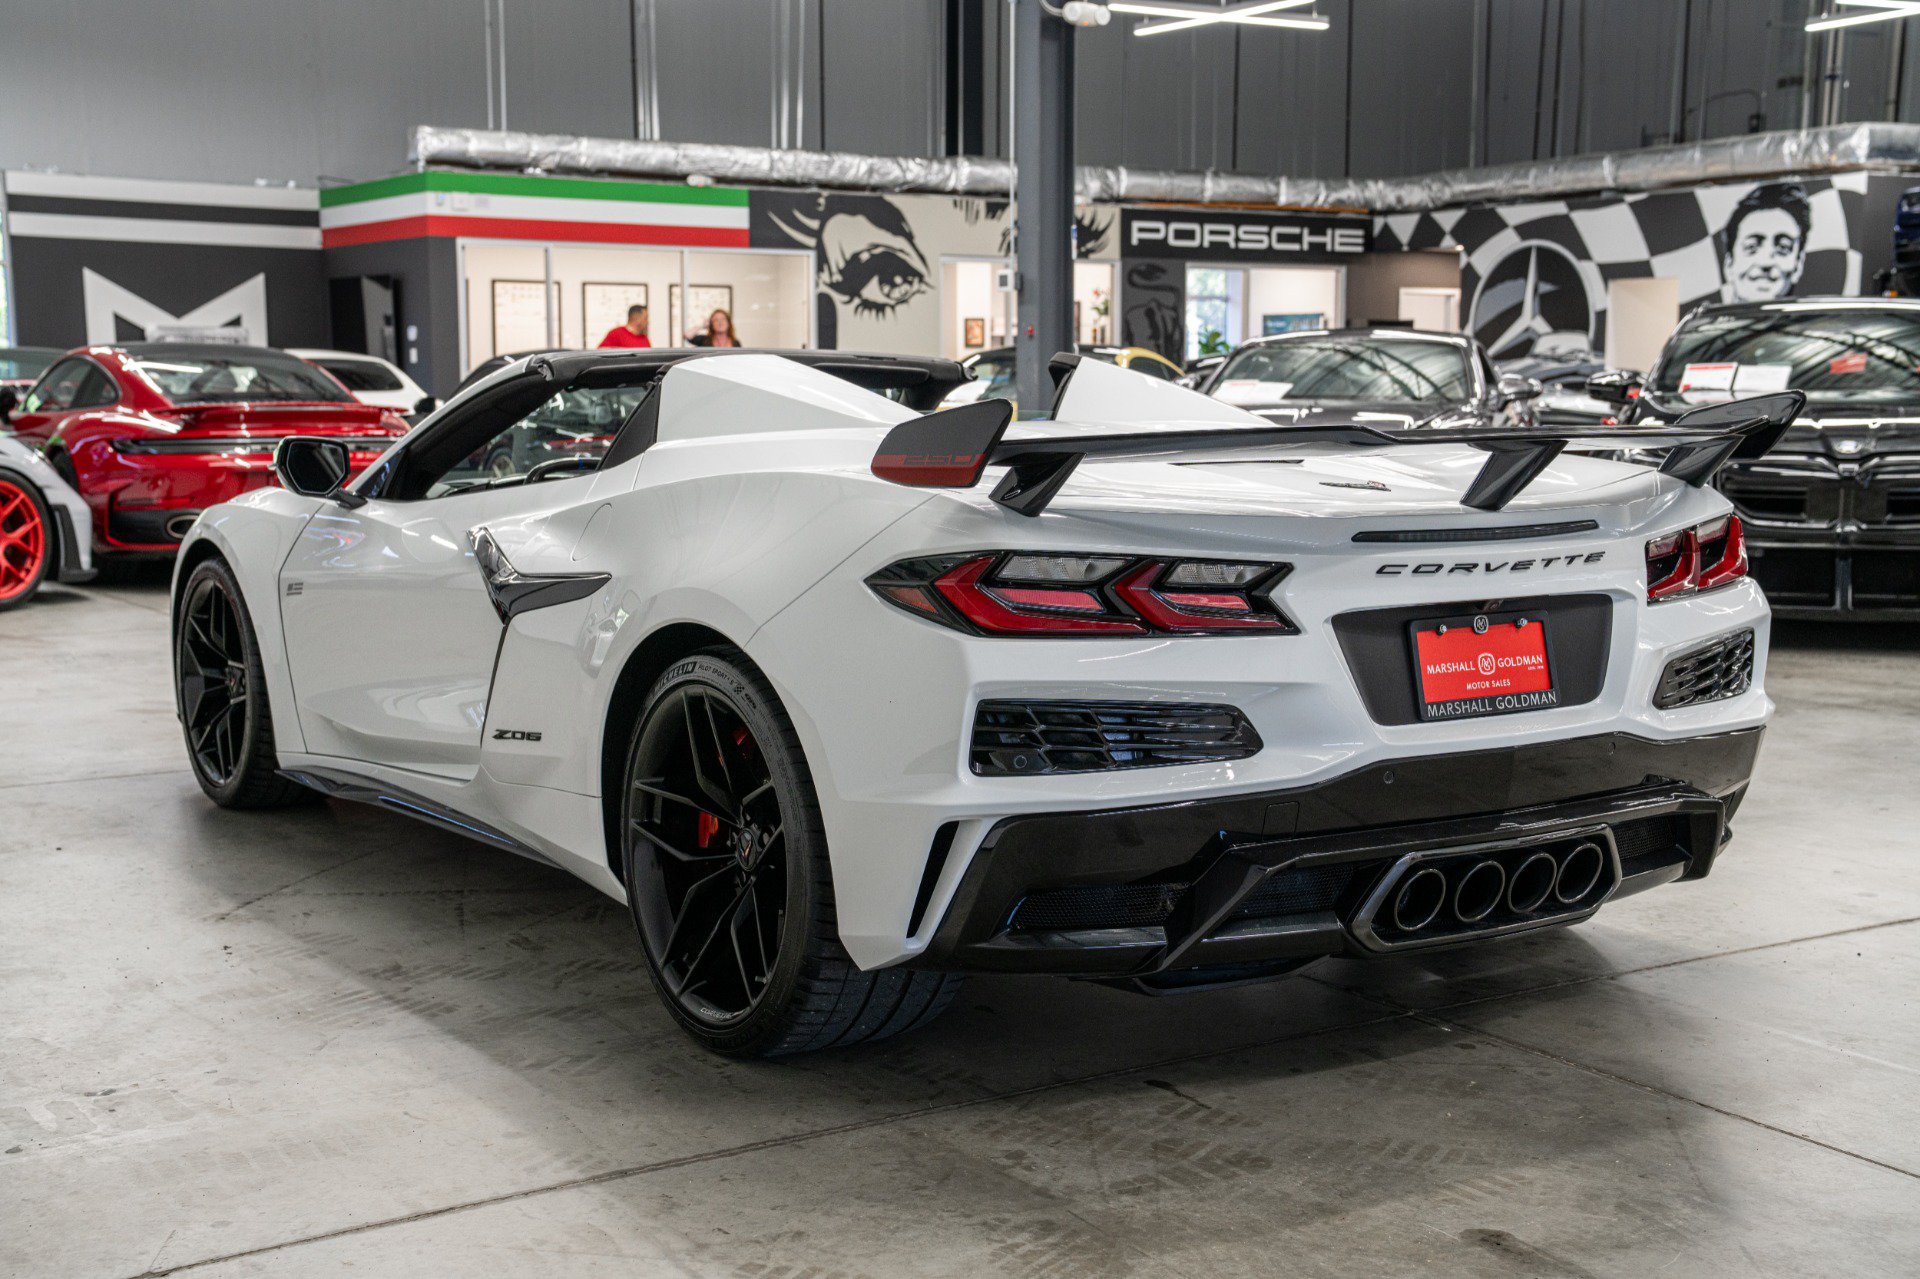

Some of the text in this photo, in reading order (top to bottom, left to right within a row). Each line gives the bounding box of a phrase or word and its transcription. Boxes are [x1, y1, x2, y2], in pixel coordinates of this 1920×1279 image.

[1131, 220, 1365, 253] PORSCHE
[1375, 551, 1606, 575] CORVETTE
[1427, 660, 1476, 675] MARSHALL
[1497, 654, 1543, 668] GOLDMAN
[1466, 678, 1511, 691] MOTOR SALES
[1427, 690, 1557, 718] MARSHALL GOLDMAN
[492, 729, 542, 742] Z06
